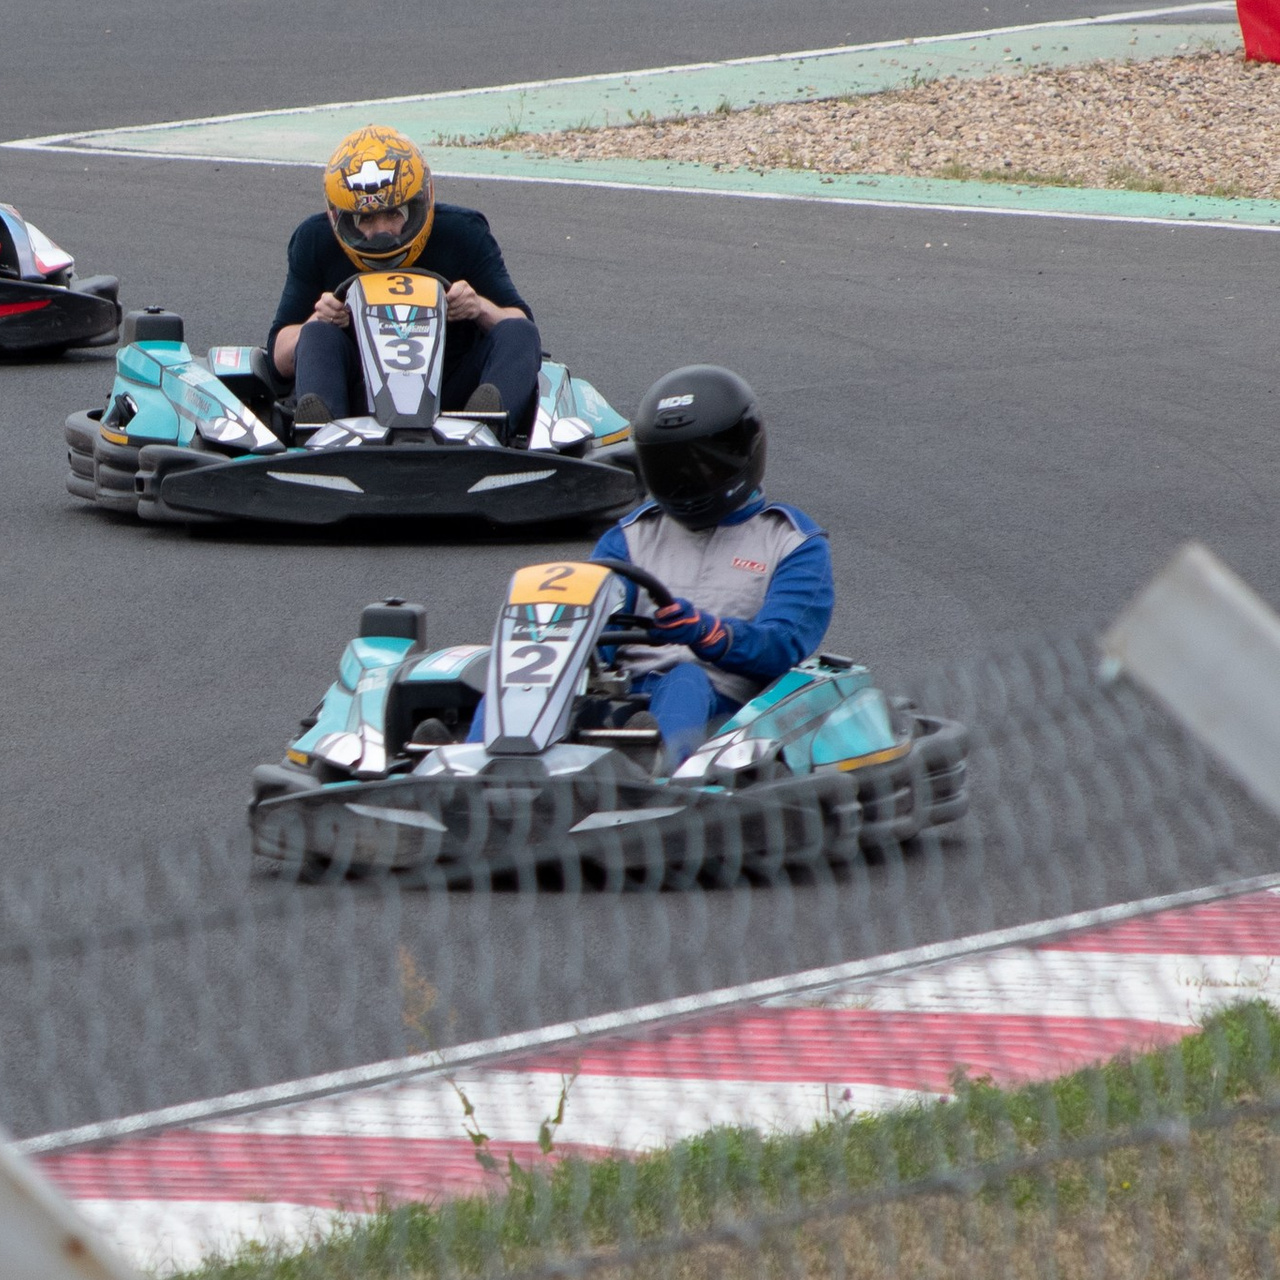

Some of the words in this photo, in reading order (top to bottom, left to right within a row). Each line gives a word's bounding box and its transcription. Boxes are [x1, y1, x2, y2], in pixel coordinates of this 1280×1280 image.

[387, 275, 414, 296] 3
[383, 339, 426, 371] 3
[657, 394, 695, 410] MDS
[538, 565, 575, 591] 2
[505, 644, 558, 684] 2
